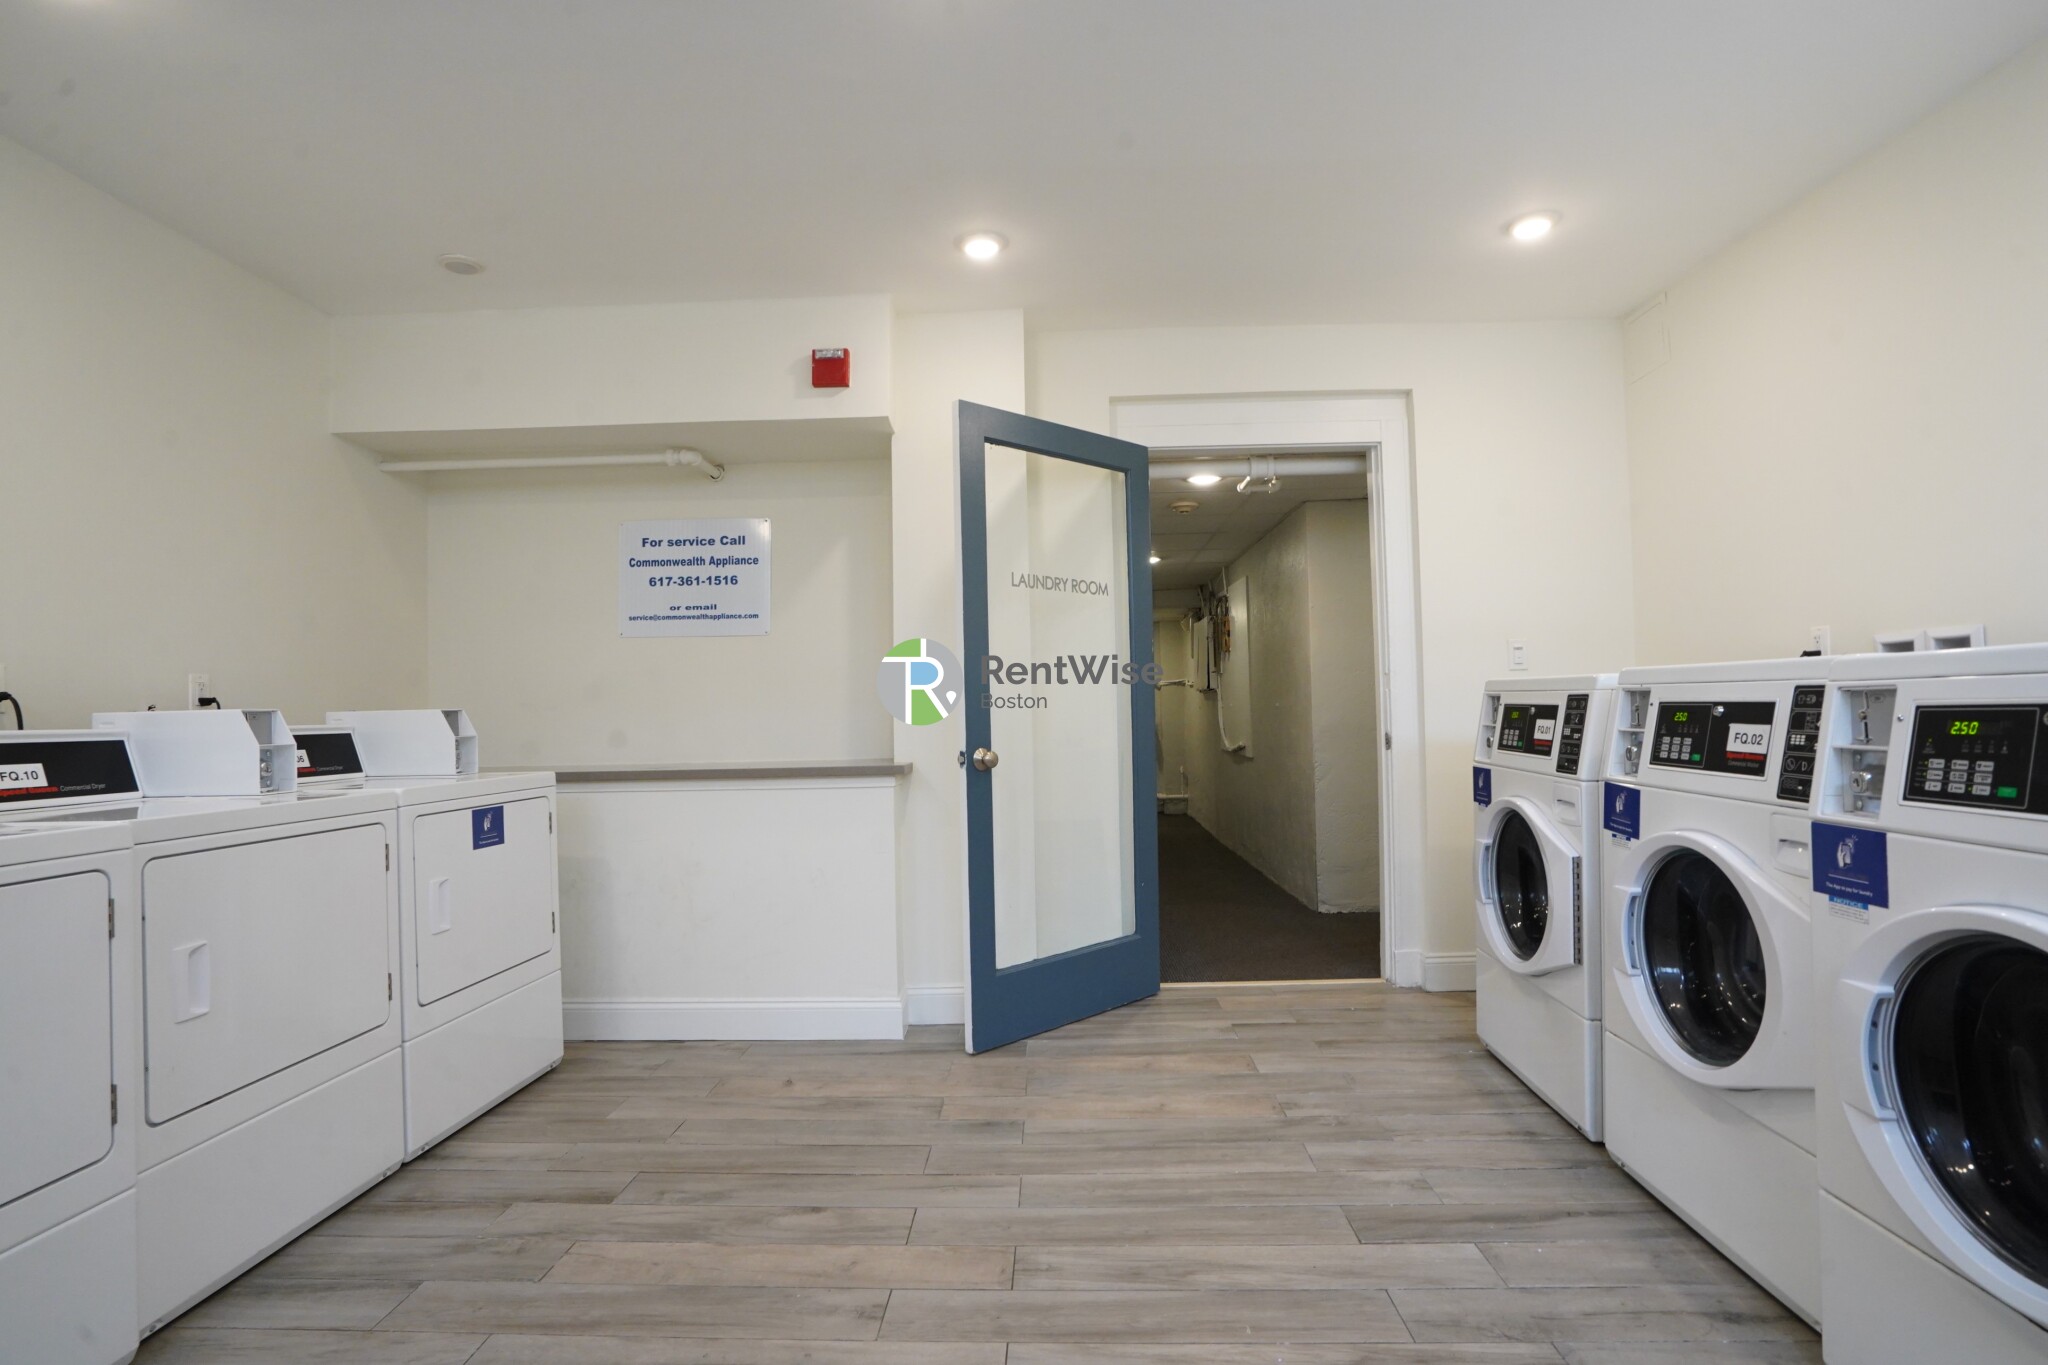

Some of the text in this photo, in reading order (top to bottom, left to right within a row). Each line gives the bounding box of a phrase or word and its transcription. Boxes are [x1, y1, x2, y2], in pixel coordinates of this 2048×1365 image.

[642, 535, 746, 547] For service Call
[629, 555, 759, 568] Commonwealth Appliance
[649, 575, 739, 587] 617-361-1516
[1011, 571, 1109, 596] LAUNDRY ROOM
[685, 603, 717, 611] email
[629, 613, 759, 621] service@commonwealthappliance.com
[1537, 725, 1552, 735] FQ.01
[1950, 721, 1979, 735] 2.50
[1734, 732, 1764, 746] FQ.02
[0, 770, 39, 782] FQ.10
